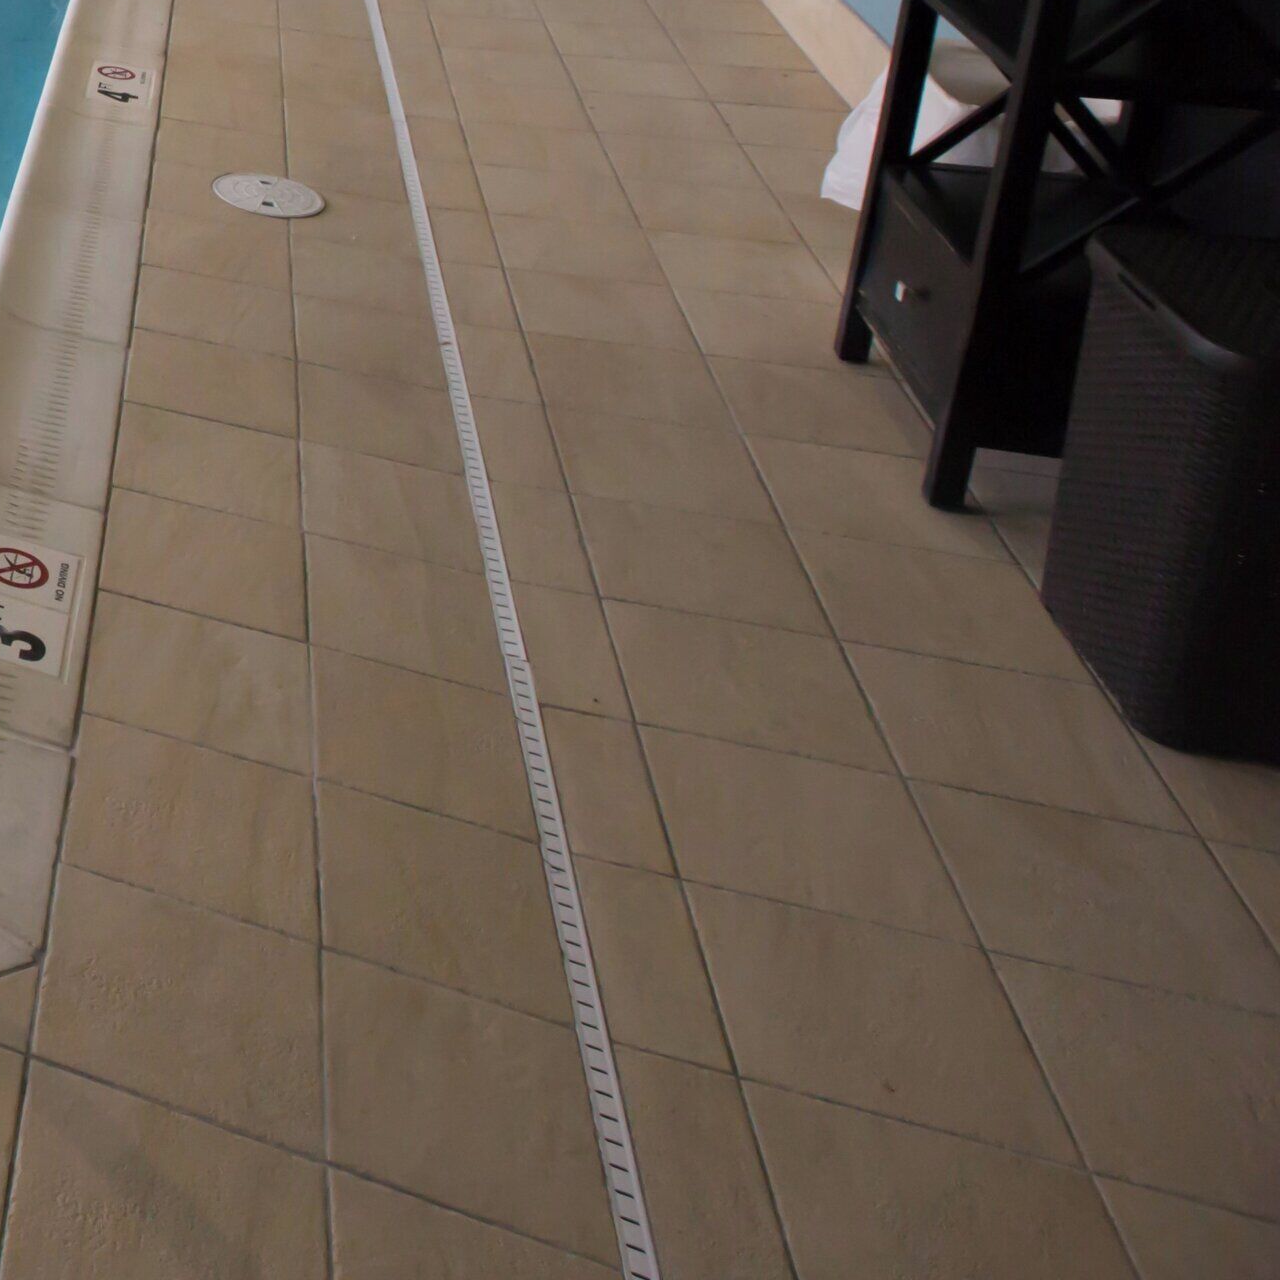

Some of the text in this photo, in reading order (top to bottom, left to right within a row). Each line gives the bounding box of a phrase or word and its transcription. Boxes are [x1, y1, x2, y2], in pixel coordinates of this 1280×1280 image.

[97, 89, 138, 103] 4
[54, 563, 70, 602] NO DIVING
